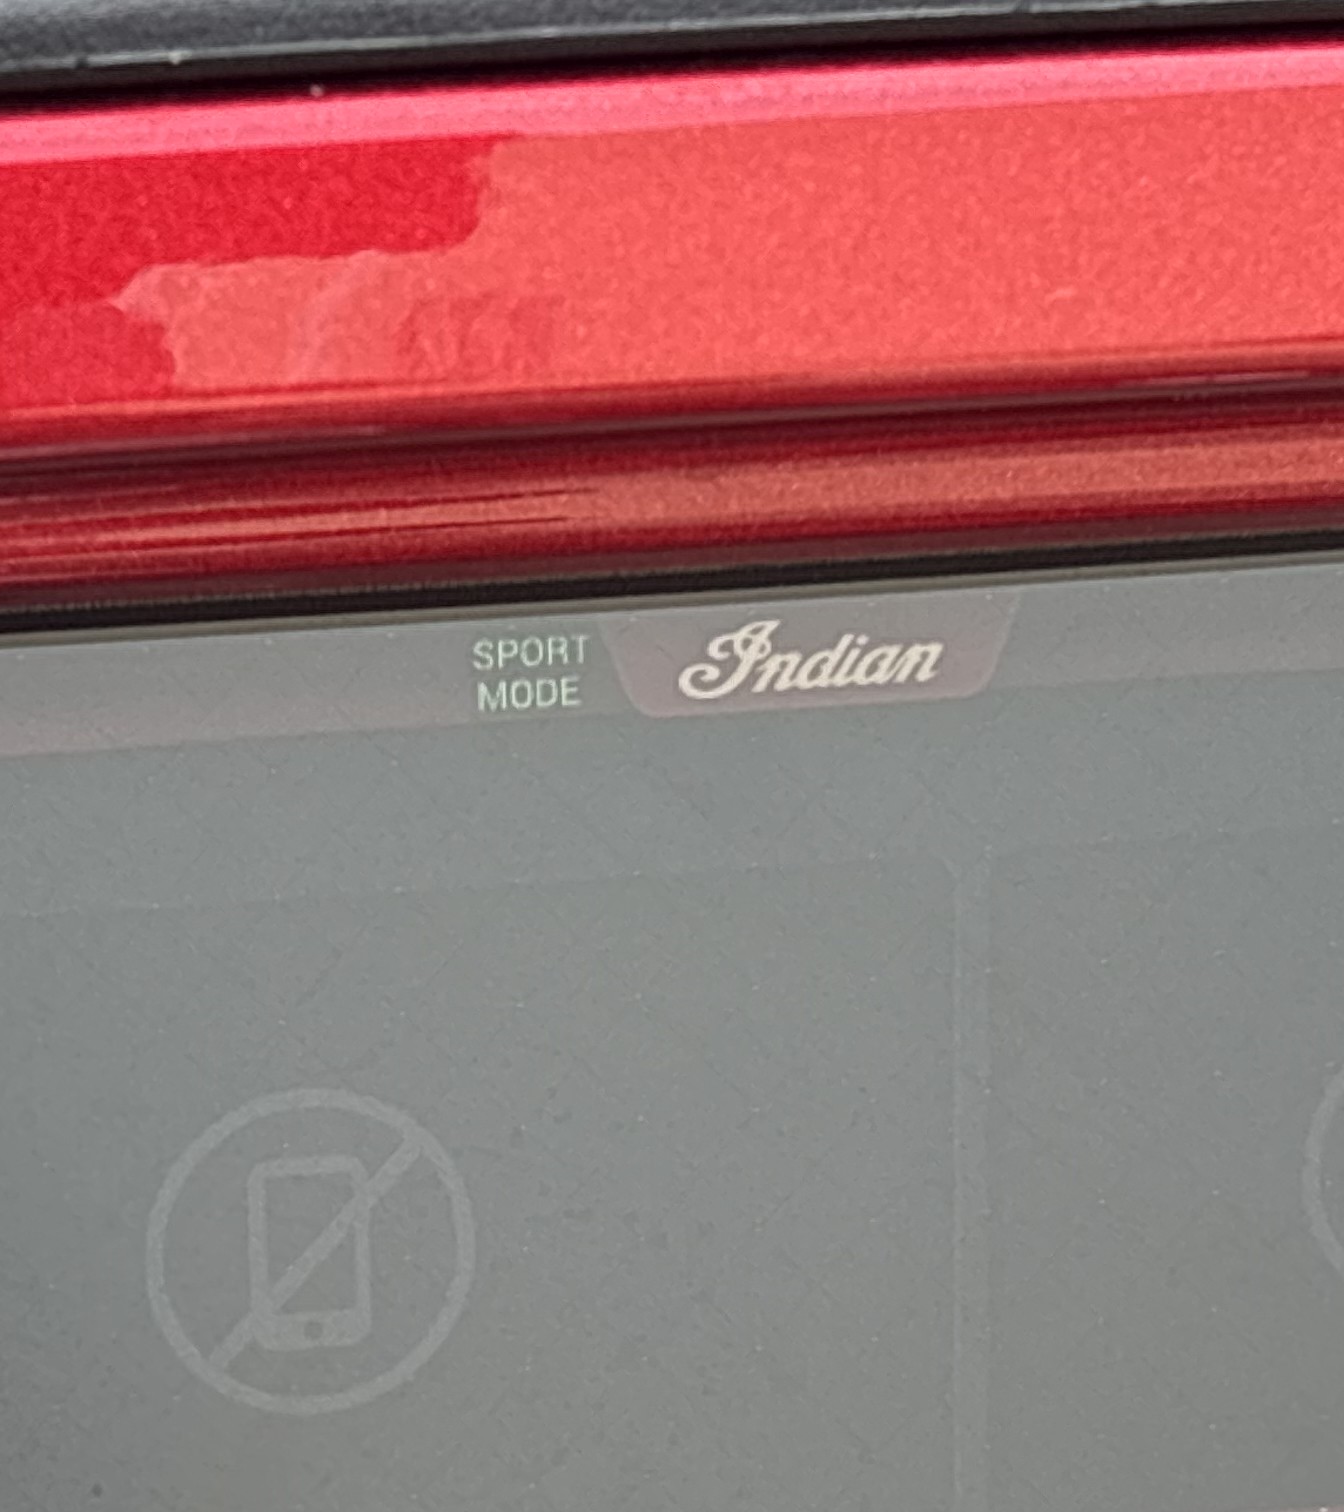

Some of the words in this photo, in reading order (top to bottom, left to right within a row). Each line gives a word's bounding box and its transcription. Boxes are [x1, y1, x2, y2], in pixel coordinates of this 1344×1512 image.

[471, 634, 590, 672] SPORT
[677, 618, 946, 701] Indian
[476, 677, 582, 713] MODE
